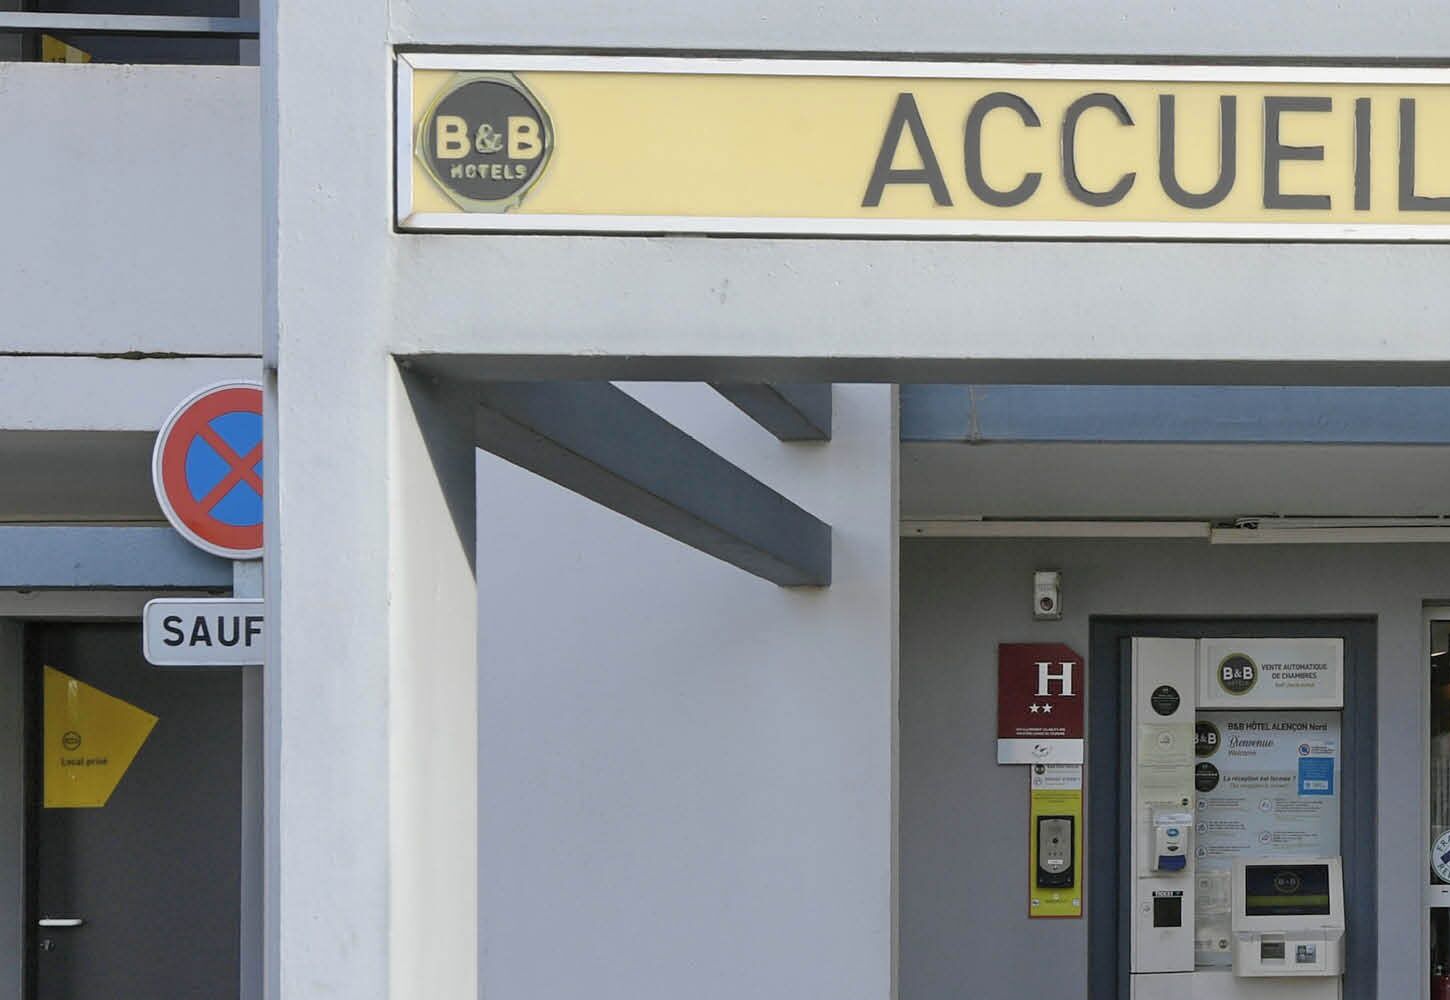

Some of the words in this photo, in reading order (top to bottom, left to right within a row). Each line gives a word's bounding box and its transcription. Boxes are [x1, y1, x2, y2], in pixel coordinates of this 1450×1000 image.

[436, 115, 543, 160] B&B
[450, 163, 528, 180] HOTELS
[162, 615, 265, 647] SAUF
[1033, 661, 1077, 697] H
[1222, 666, 1254, 681] B&B
